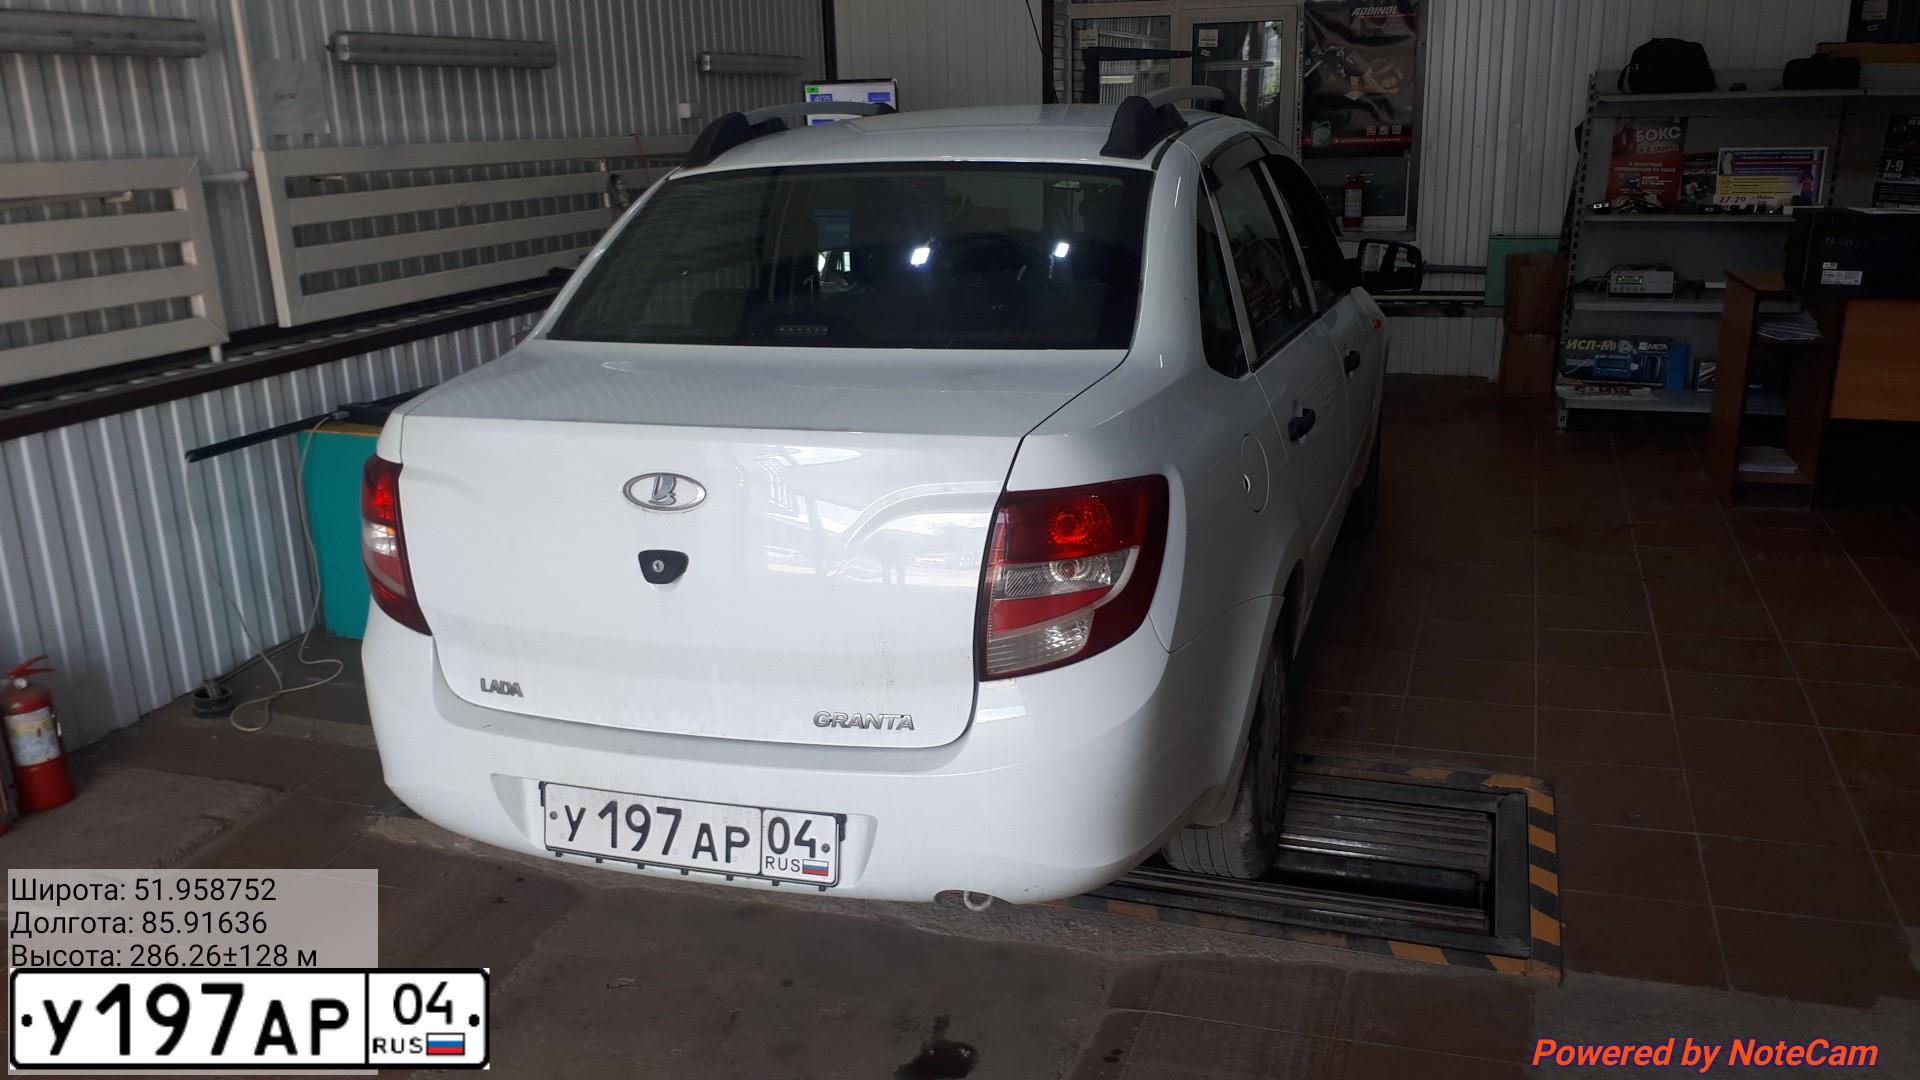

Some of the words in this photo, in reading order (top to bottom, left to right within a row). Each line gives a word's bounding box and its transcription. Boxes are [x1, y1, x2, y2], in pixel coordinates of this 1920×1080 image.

[1351, 6, 1398, 16] ADDINOL
[1636, 126, 1681, 143] БОКС
[480, 677, 524, 698] LADA
[813, 710, 915, 732] GRANTA
[768, 816, 817, 858] 04
[765, 855, 801, 873] RUS
